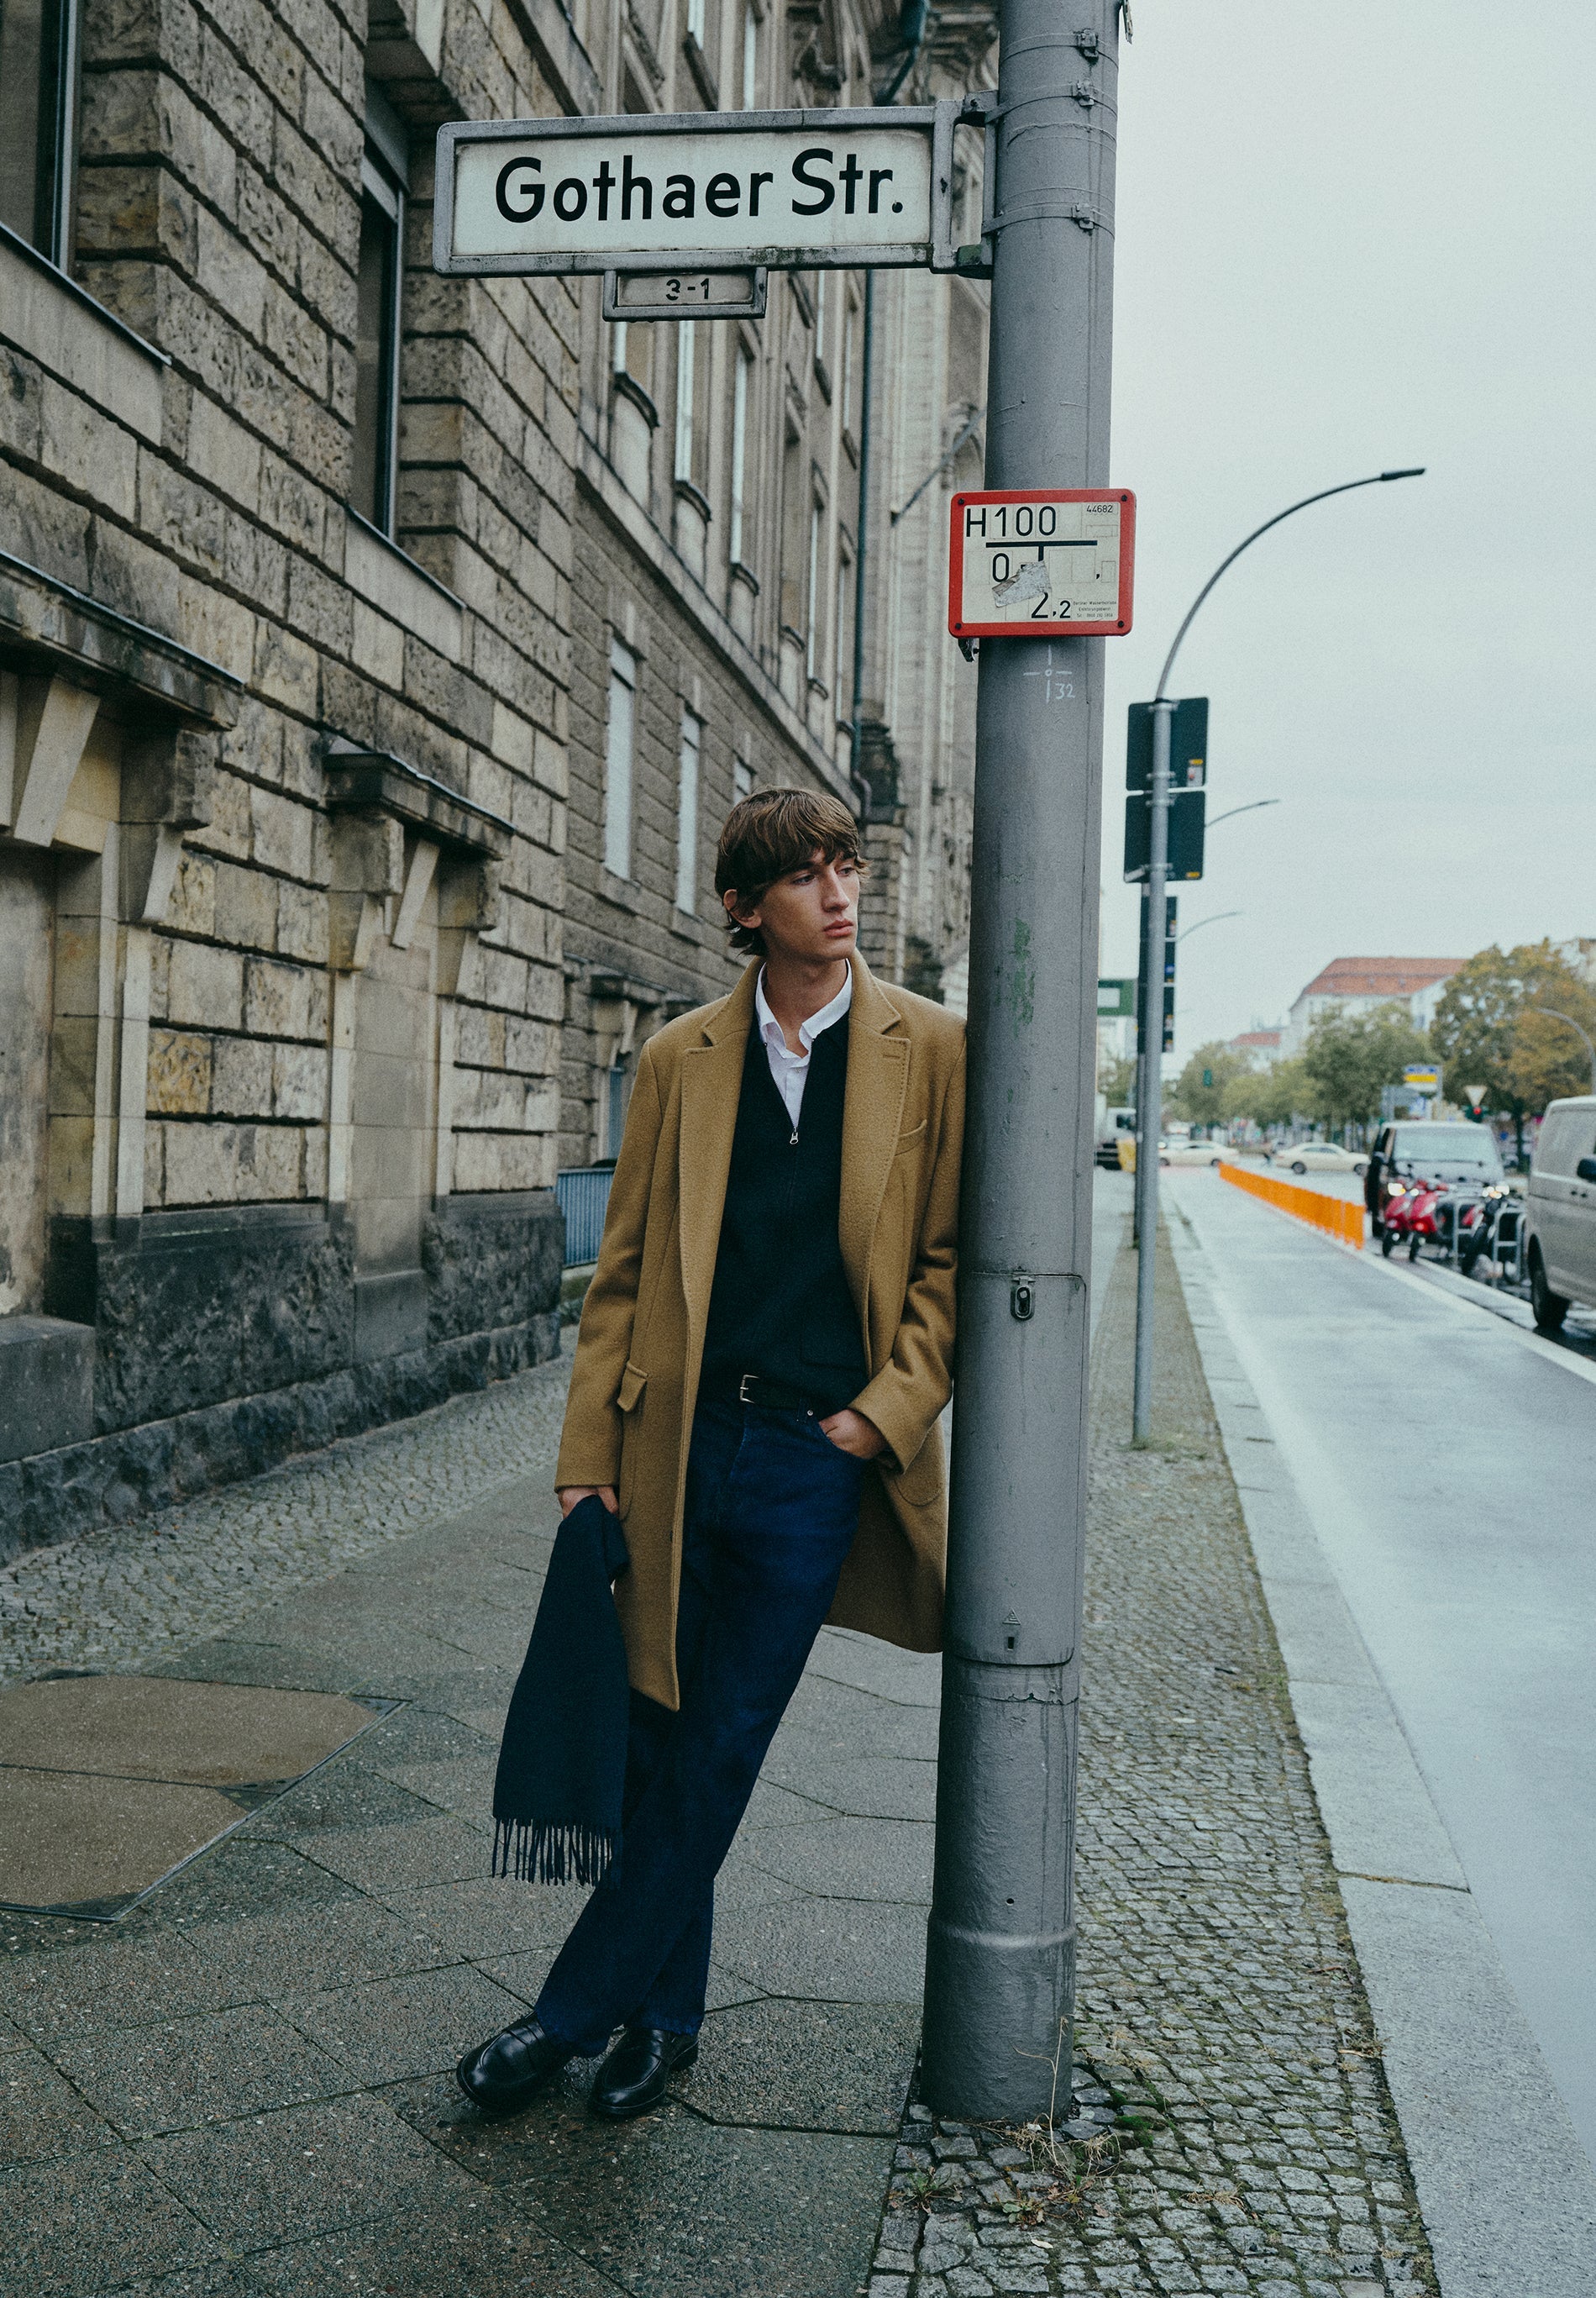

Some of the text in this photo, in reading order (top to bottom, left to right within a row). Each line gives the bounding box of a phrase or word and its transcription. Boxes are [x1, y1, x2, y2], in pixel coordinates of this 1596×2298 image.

[496, 148, 904, 223] Gothaer Str.
[665, 278, 710, 302] 3-1
[1086, 504, 1114, 513] 44682
[966, 506, 1057, 538] H100
[1055, 683, 1076, 700] 32
